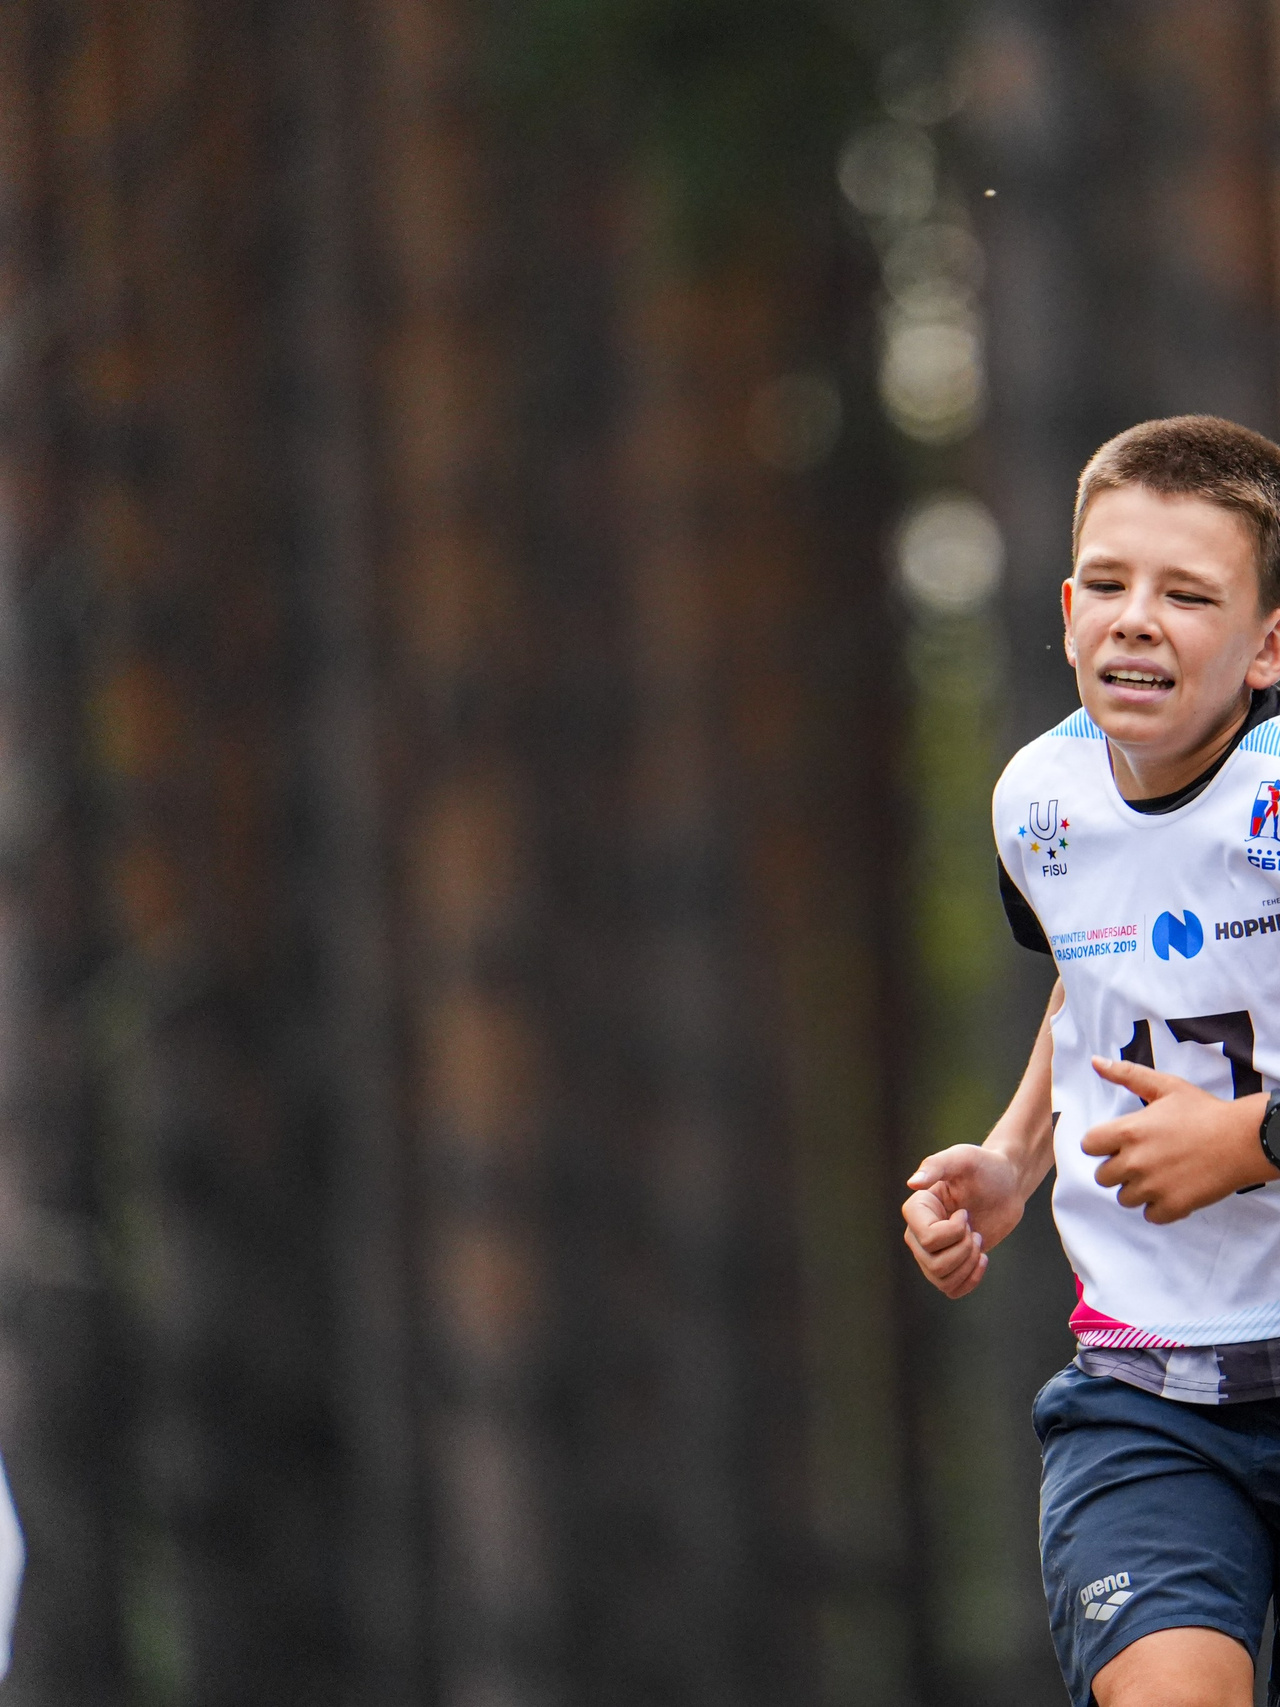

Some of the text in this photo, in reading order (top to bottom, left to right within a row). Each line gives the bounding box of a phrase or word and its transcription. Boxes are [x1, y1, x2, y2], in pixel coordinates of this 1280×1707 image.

[1042, 863, 1068, 877] FISU
[1060, 931, 1086, 944] WINTER
[1087, 925, 1137, 940] UNIVERSIADE
[1113, 940, 1137, 953] 2019
[1080, 1571, 1130, 1605] arena
